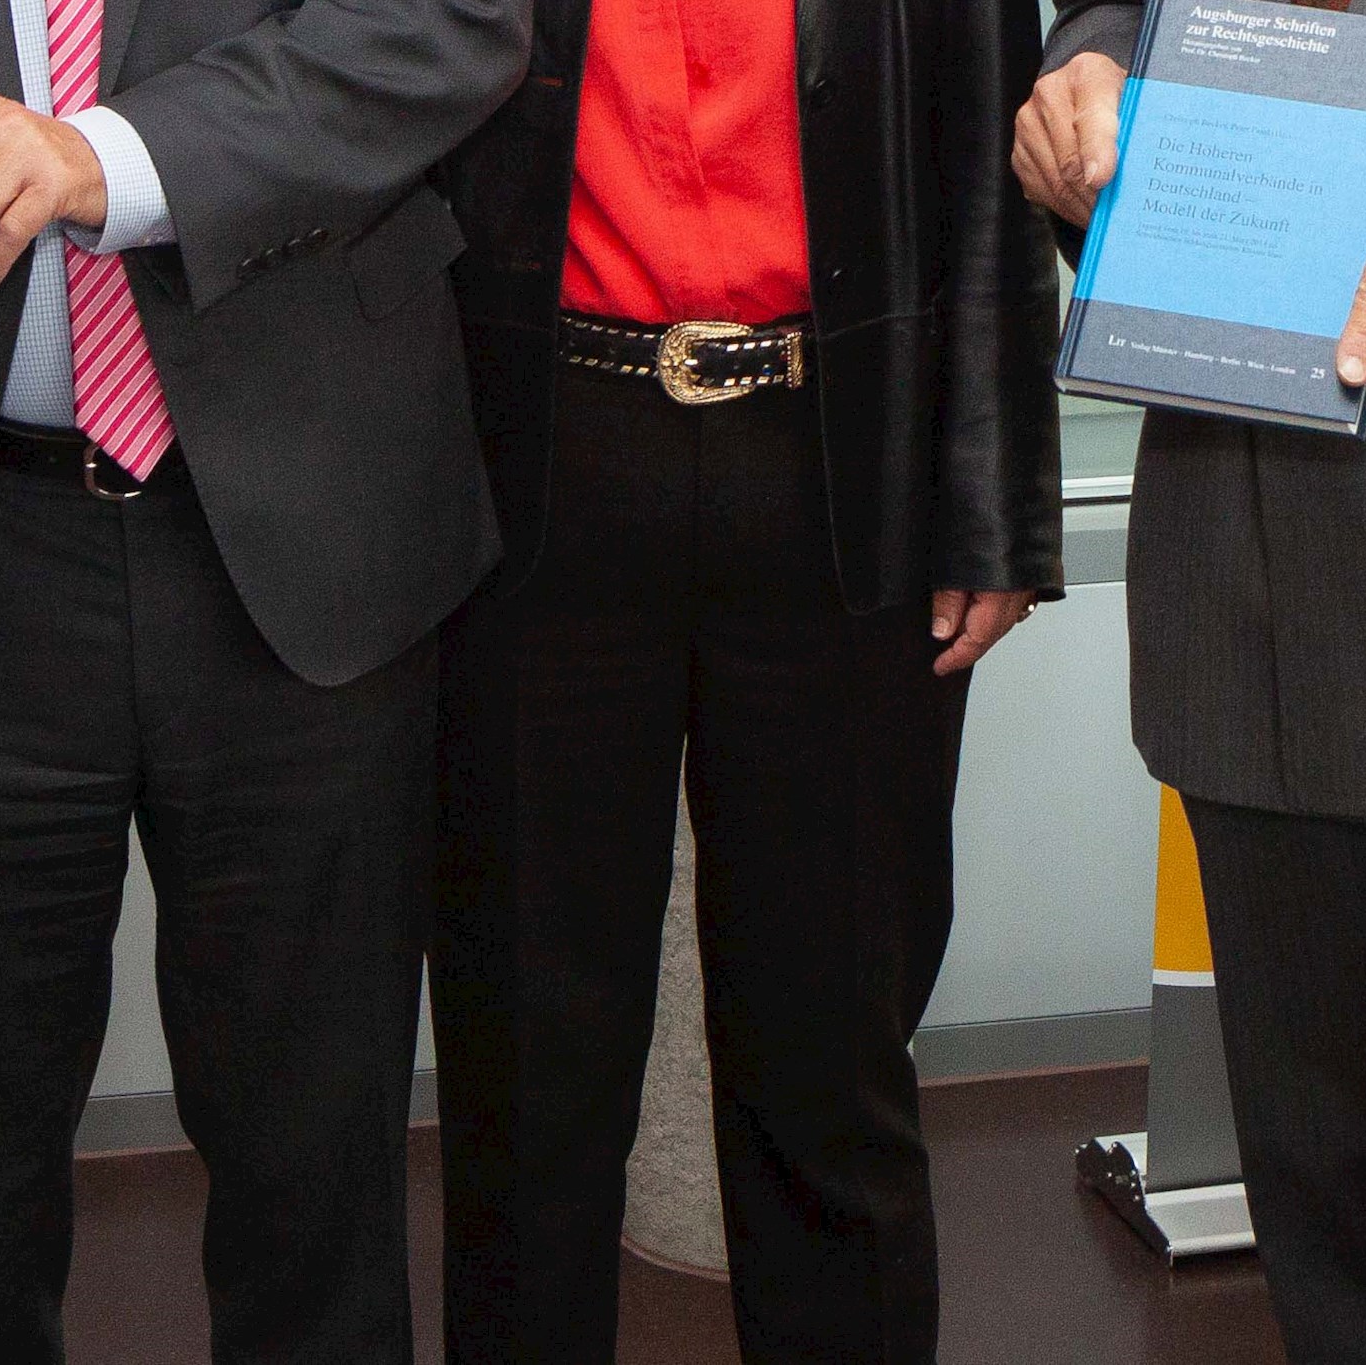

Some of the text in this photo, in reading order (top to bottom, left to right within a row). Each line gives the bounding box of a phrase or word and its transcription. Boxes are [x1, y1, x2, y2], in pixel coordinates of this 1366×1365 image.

[1190, 5, 1338, 38] Augsburger Schriften
[1185, 24, 1330, 54] zur Rechtsgeschichte
[1158, 136, 1185, 154] Die
[1148, 177, 1242, 204] Deutschland
[1308, 179, 1324, 196] in
[1142, 198, 1291, 233] Modell der Zukunft
[1310, 366, 1326, 380] 25
